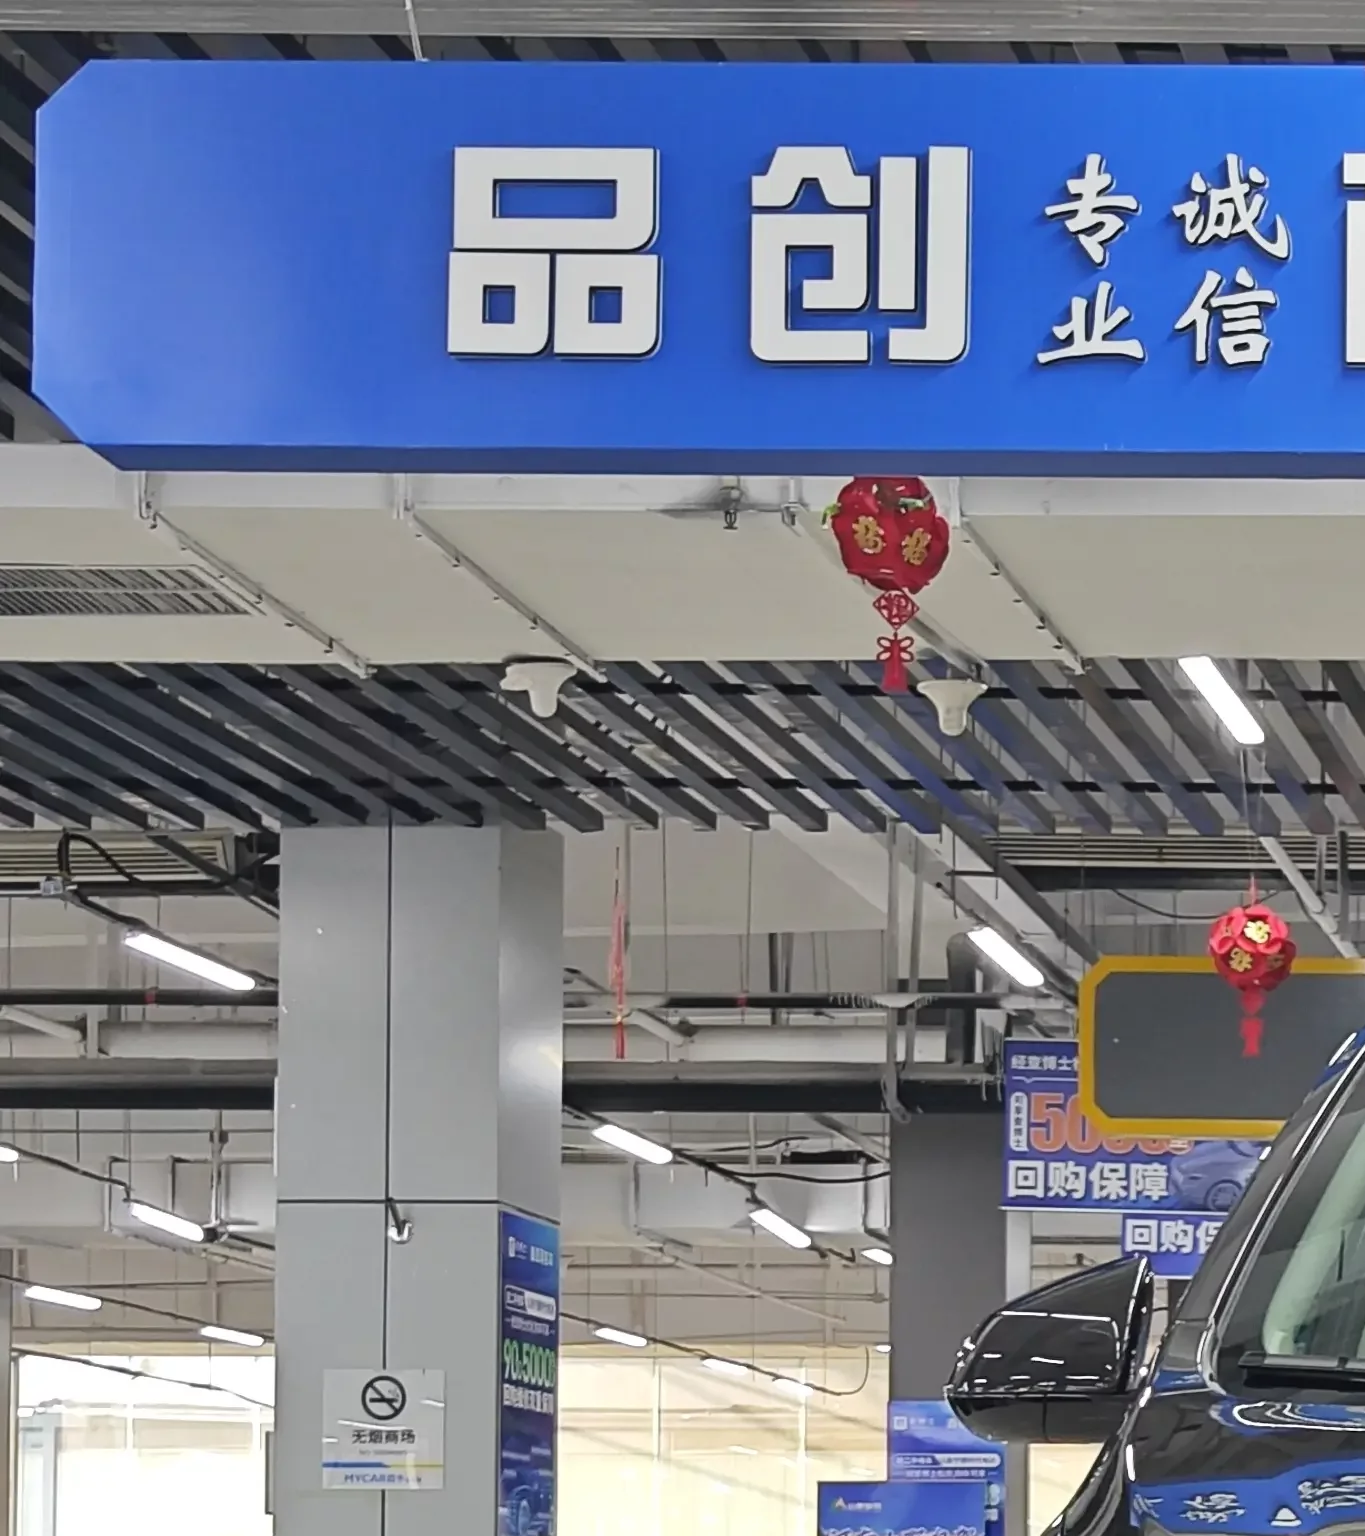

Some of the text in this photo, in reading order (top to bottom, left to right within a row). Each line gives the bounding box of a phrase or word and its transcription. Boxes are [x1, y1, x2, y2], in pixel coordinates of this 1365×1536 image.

[447, 145, 973, 365] 品创
[1006, 1159, 1170, 1202] 回购保障
[352, 1429, 415, 1445] 无烟商场
